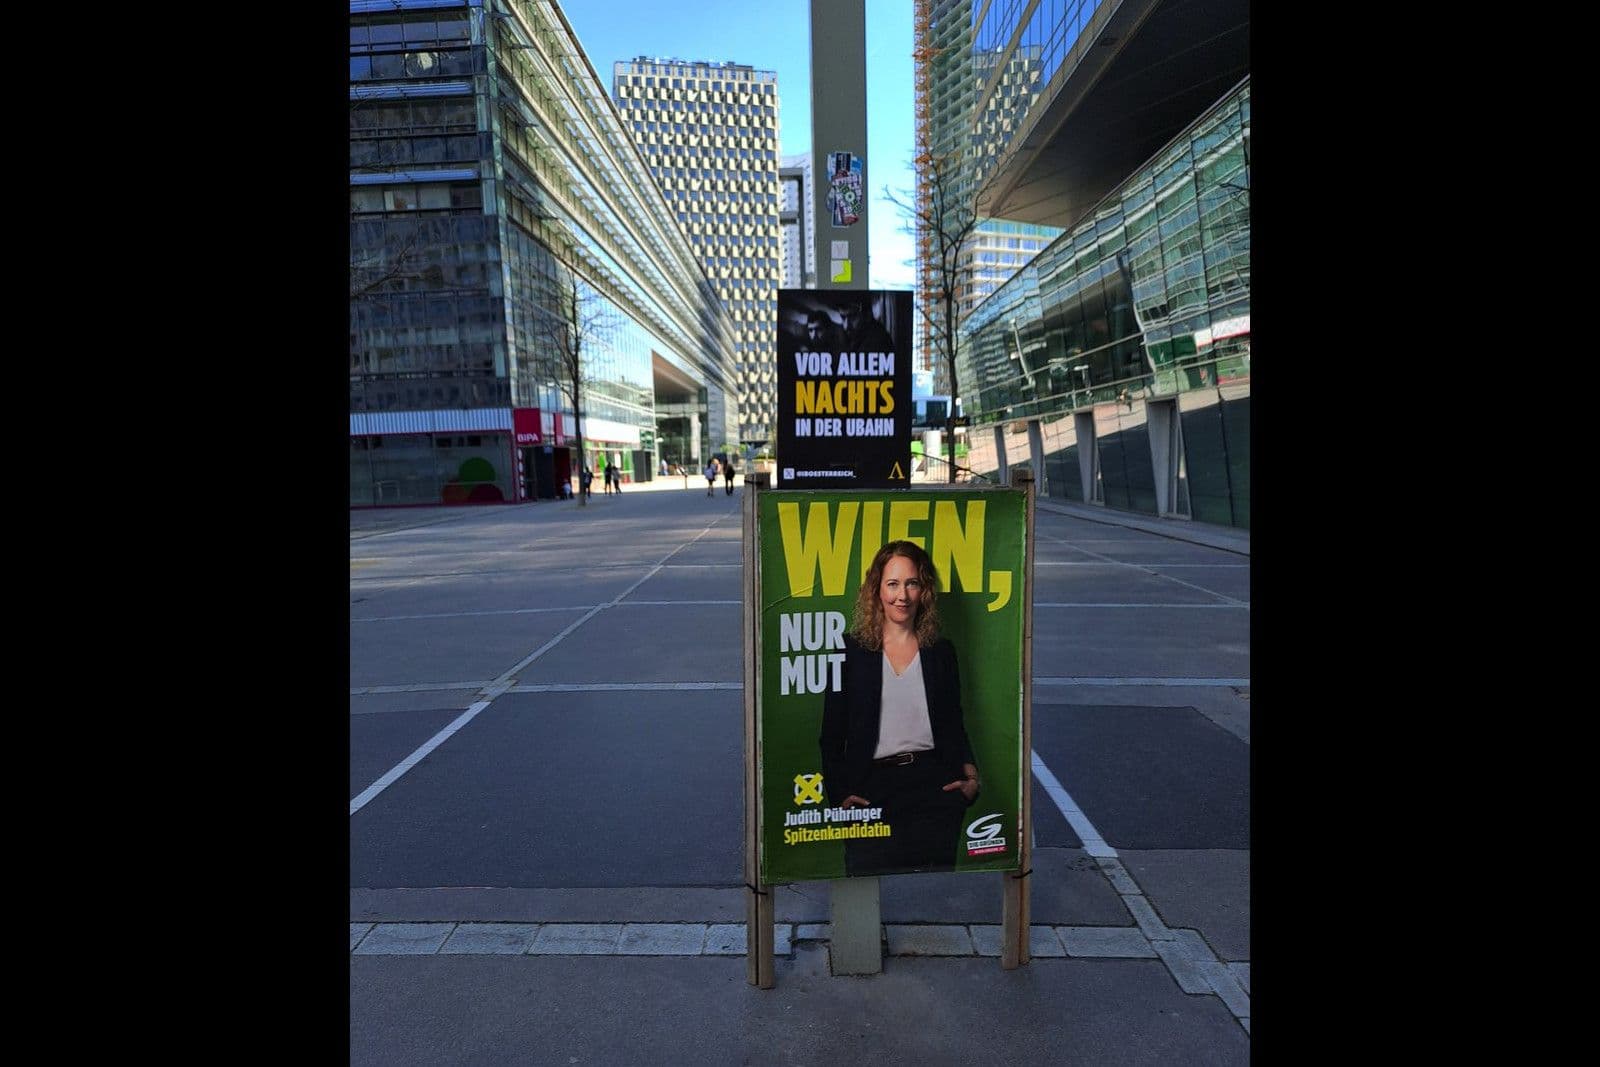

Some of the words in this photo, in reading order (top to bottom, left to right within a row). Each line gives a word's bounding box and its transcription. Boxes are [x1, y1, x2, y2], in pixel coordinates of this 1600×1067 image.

[795, 352, 832, 376] VOR
[837, 352, 895, 376] ALLEM
[795, 380, 895, 414] NACHTS
[795, 418, 811, 437] IN
[815, 418, 842, 437] DER
[846, 418, 894, 437] UBAHN
[780, 611, 846, 652] NUR
[780, 653, 846, 695] MUT
[784, 809, 821, 826] Judith
[823, 806, 882, 822] Pühringer
[784, 822, 891, 845] Spitzenkandidatin
